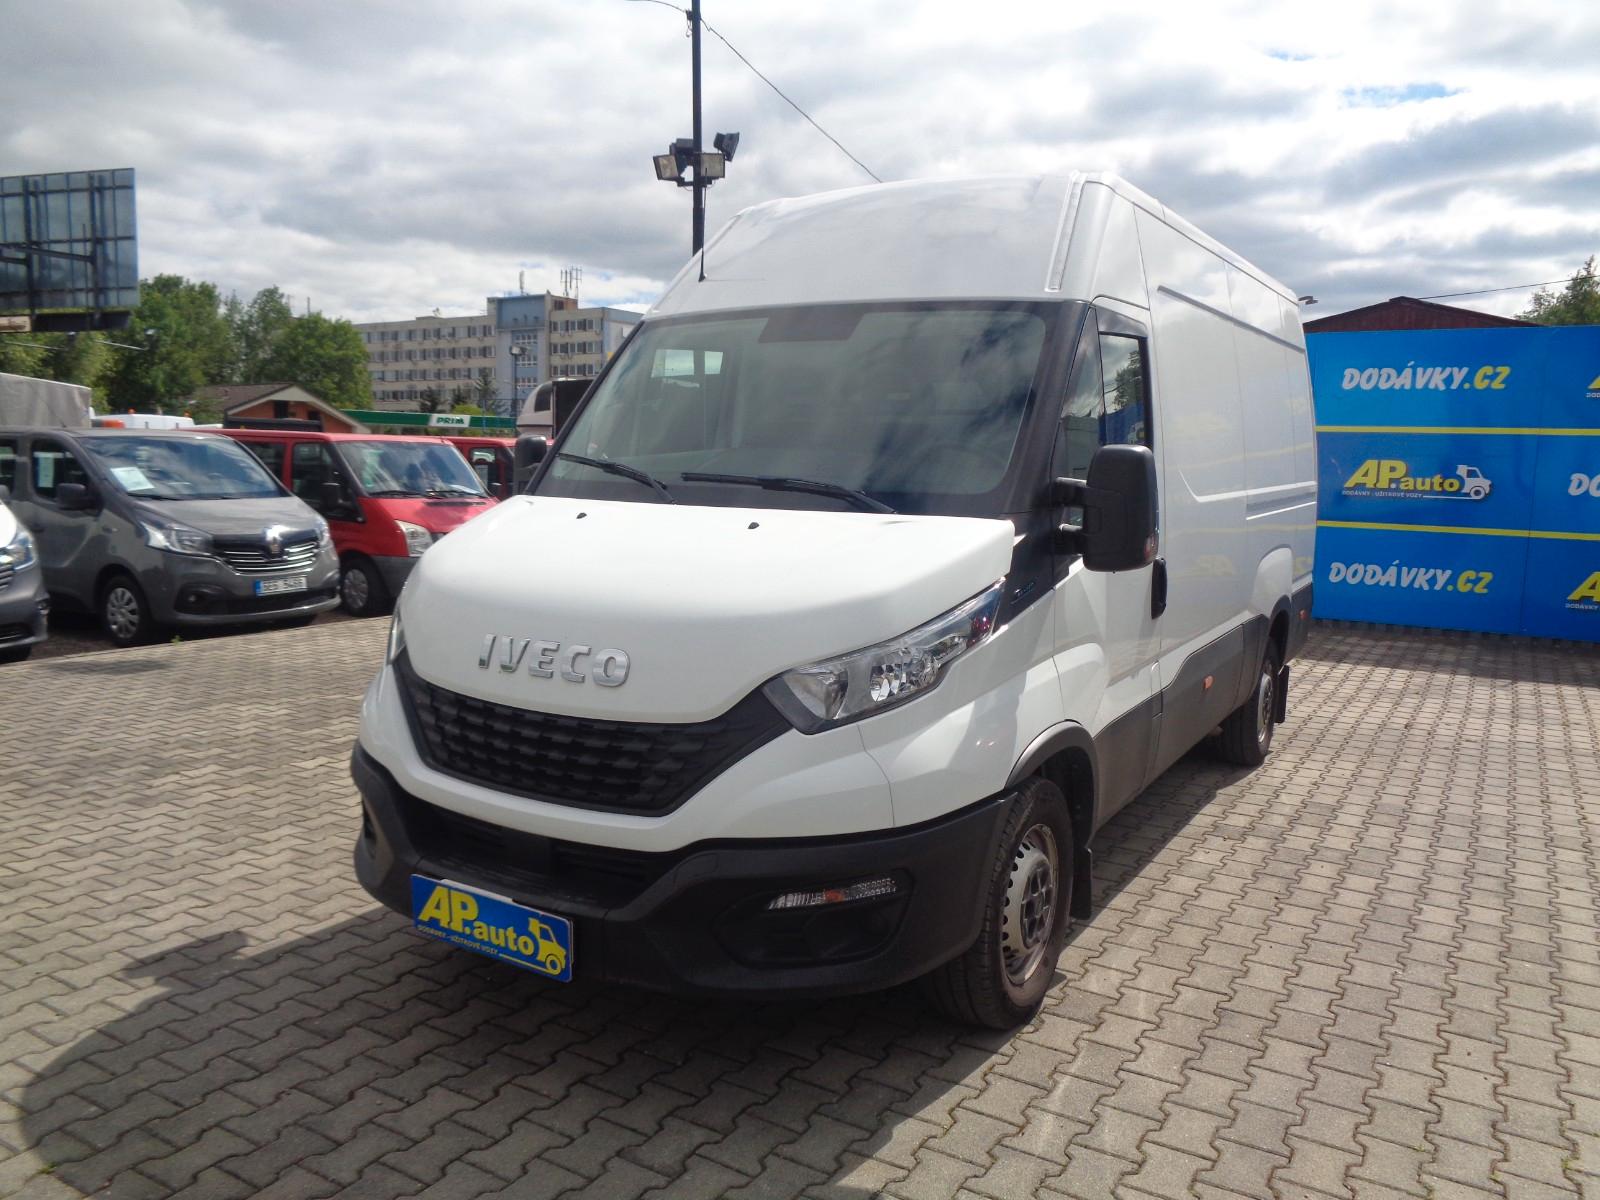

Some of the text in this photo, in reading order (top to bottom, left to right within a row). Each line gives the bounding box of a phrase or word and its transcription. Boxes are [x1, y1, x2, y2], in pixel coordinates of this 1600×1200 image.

[1341, 361, 1512, 391] DODÁVKY.CZ
[1343, 459, 1460, 492] AP.auto
[1328, 559, 1494, 594] DODÁVKY.CZ
[478, 633, 631, 688] IVECO
[418, 885, 535, 956] AP.auto
